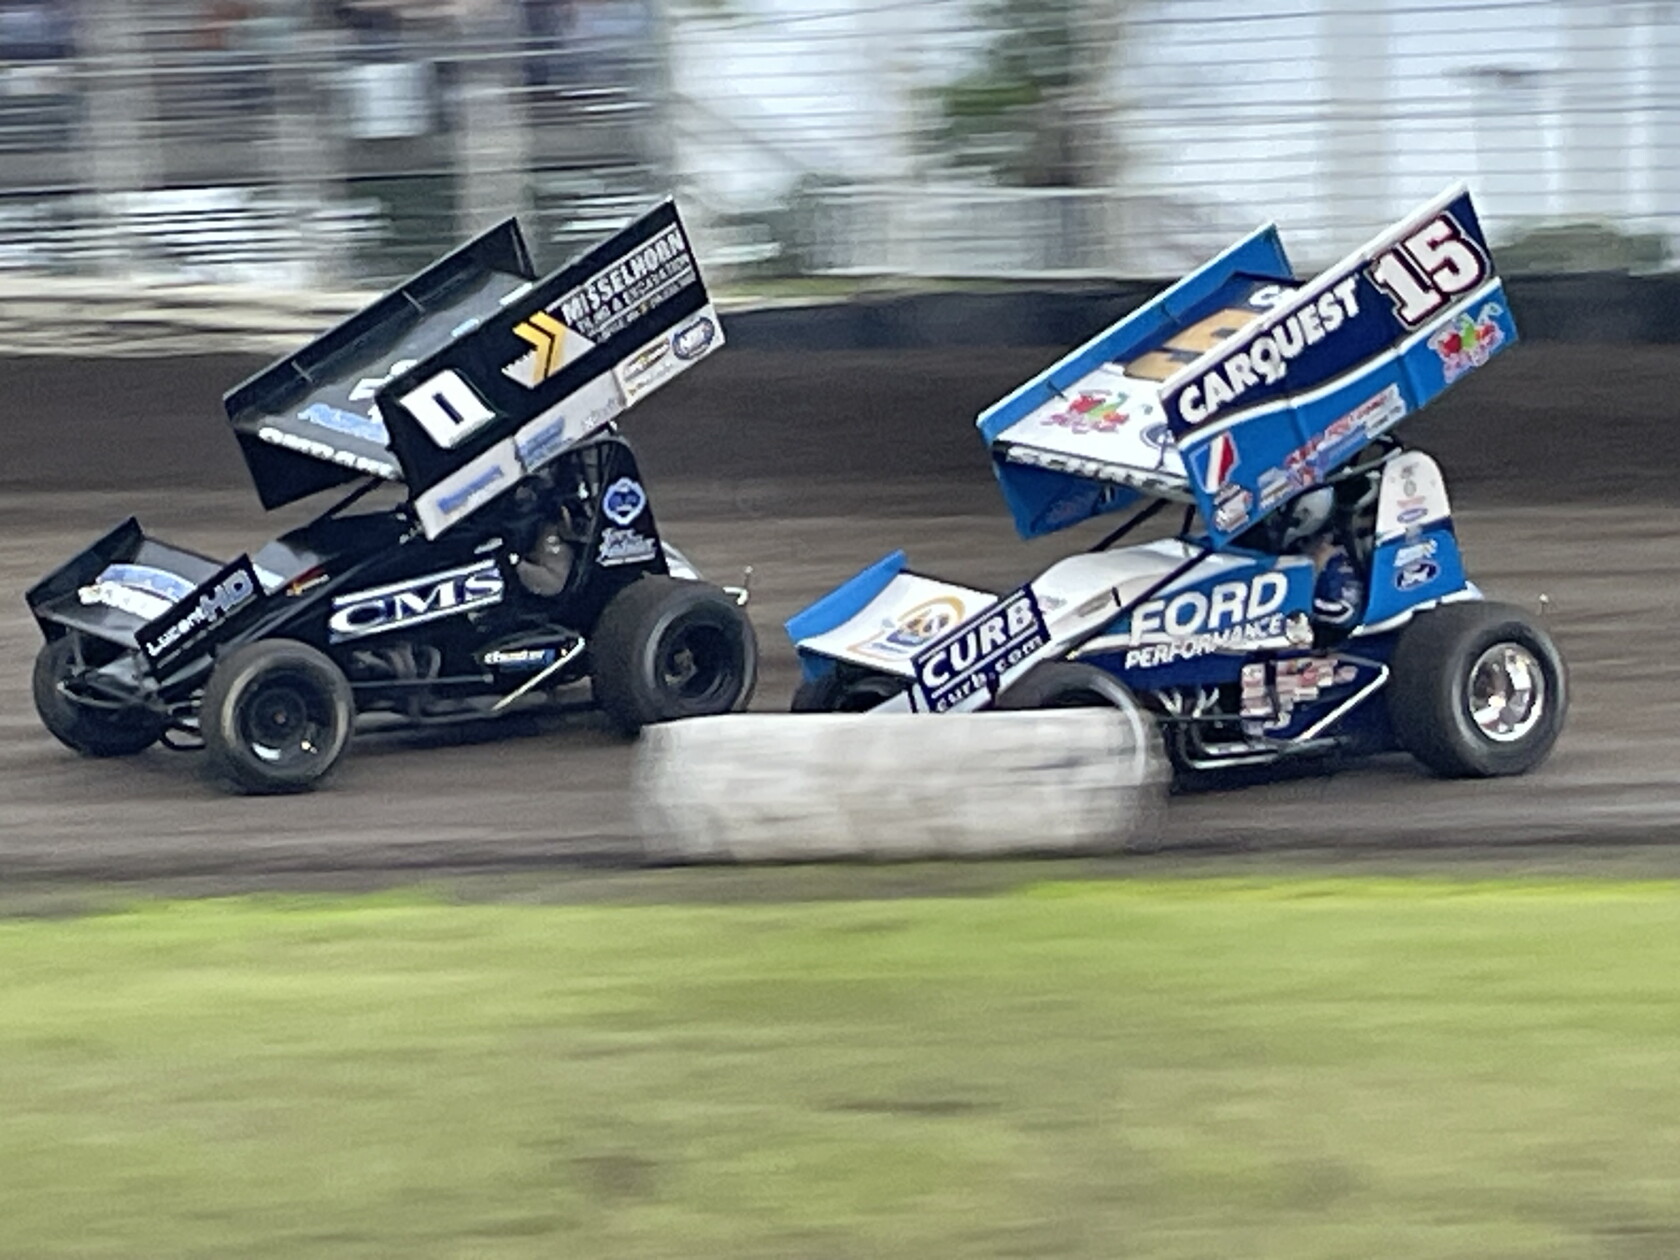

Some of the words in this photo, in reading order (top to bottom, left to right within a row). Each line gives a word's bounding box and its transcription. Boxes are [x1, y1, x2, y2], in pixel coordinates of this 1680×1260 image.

[561, 229, 686, 326] MISSELHORN
[1366, 212, 1489, 320] 15
[1178, 275, 1360, 425] CARQUEST
[328, 567, 505, 634] CMS
[922, 597, 1033, 688] CURB
[1124, 612, 1285, 670] PERFORMANCE
[1129, 571, 1289, 647] FORD
